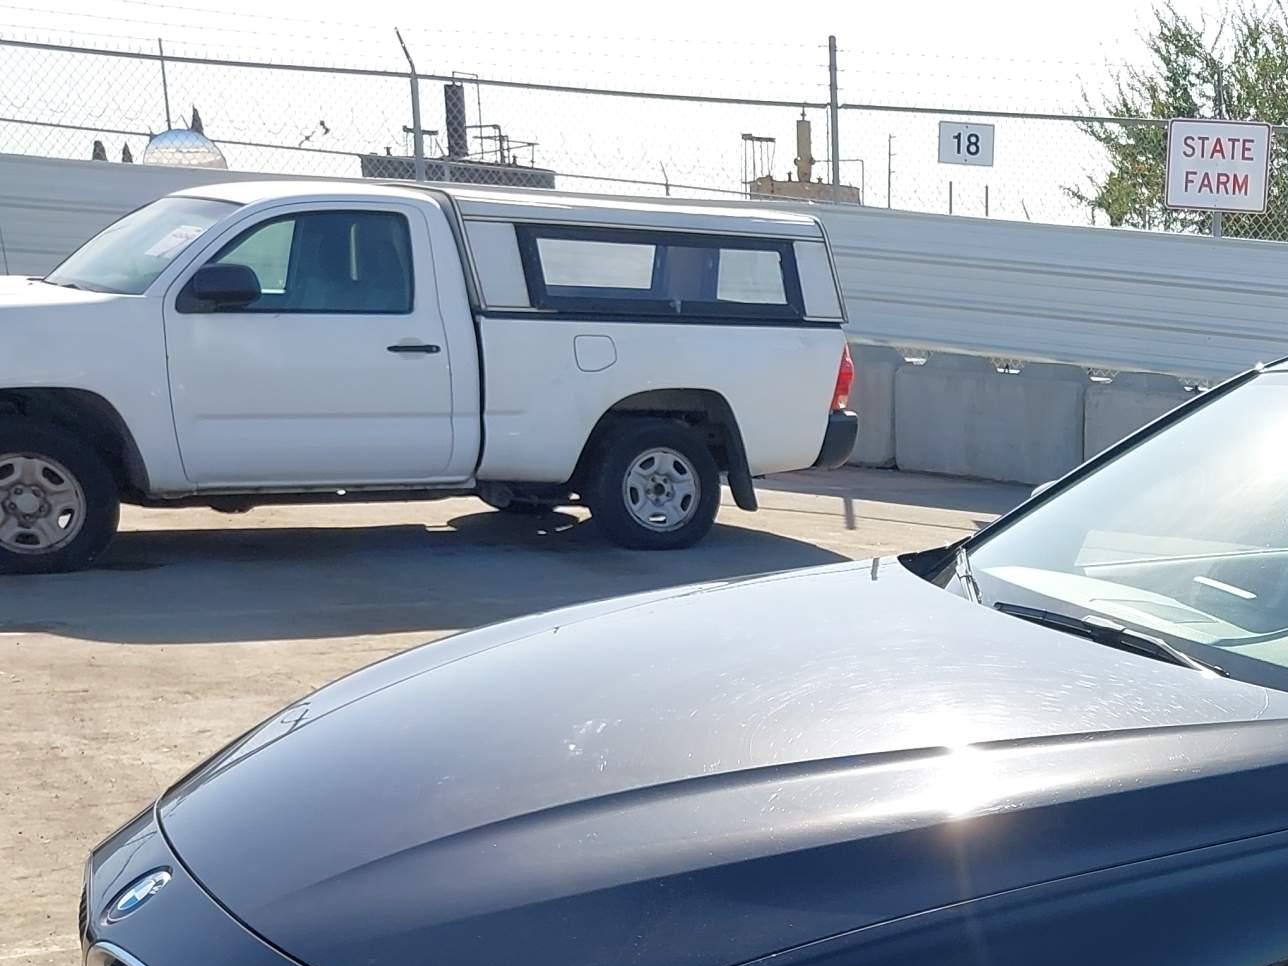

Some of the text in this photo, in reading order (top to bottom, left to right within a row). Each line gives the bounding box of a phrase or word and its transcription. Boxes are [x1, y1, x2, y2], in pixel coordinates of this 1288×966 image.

[952, 132, 980, 156] 18
[1182, 135, 1255, 161] STATE
[1184, 170, 1249, 196] FARM
